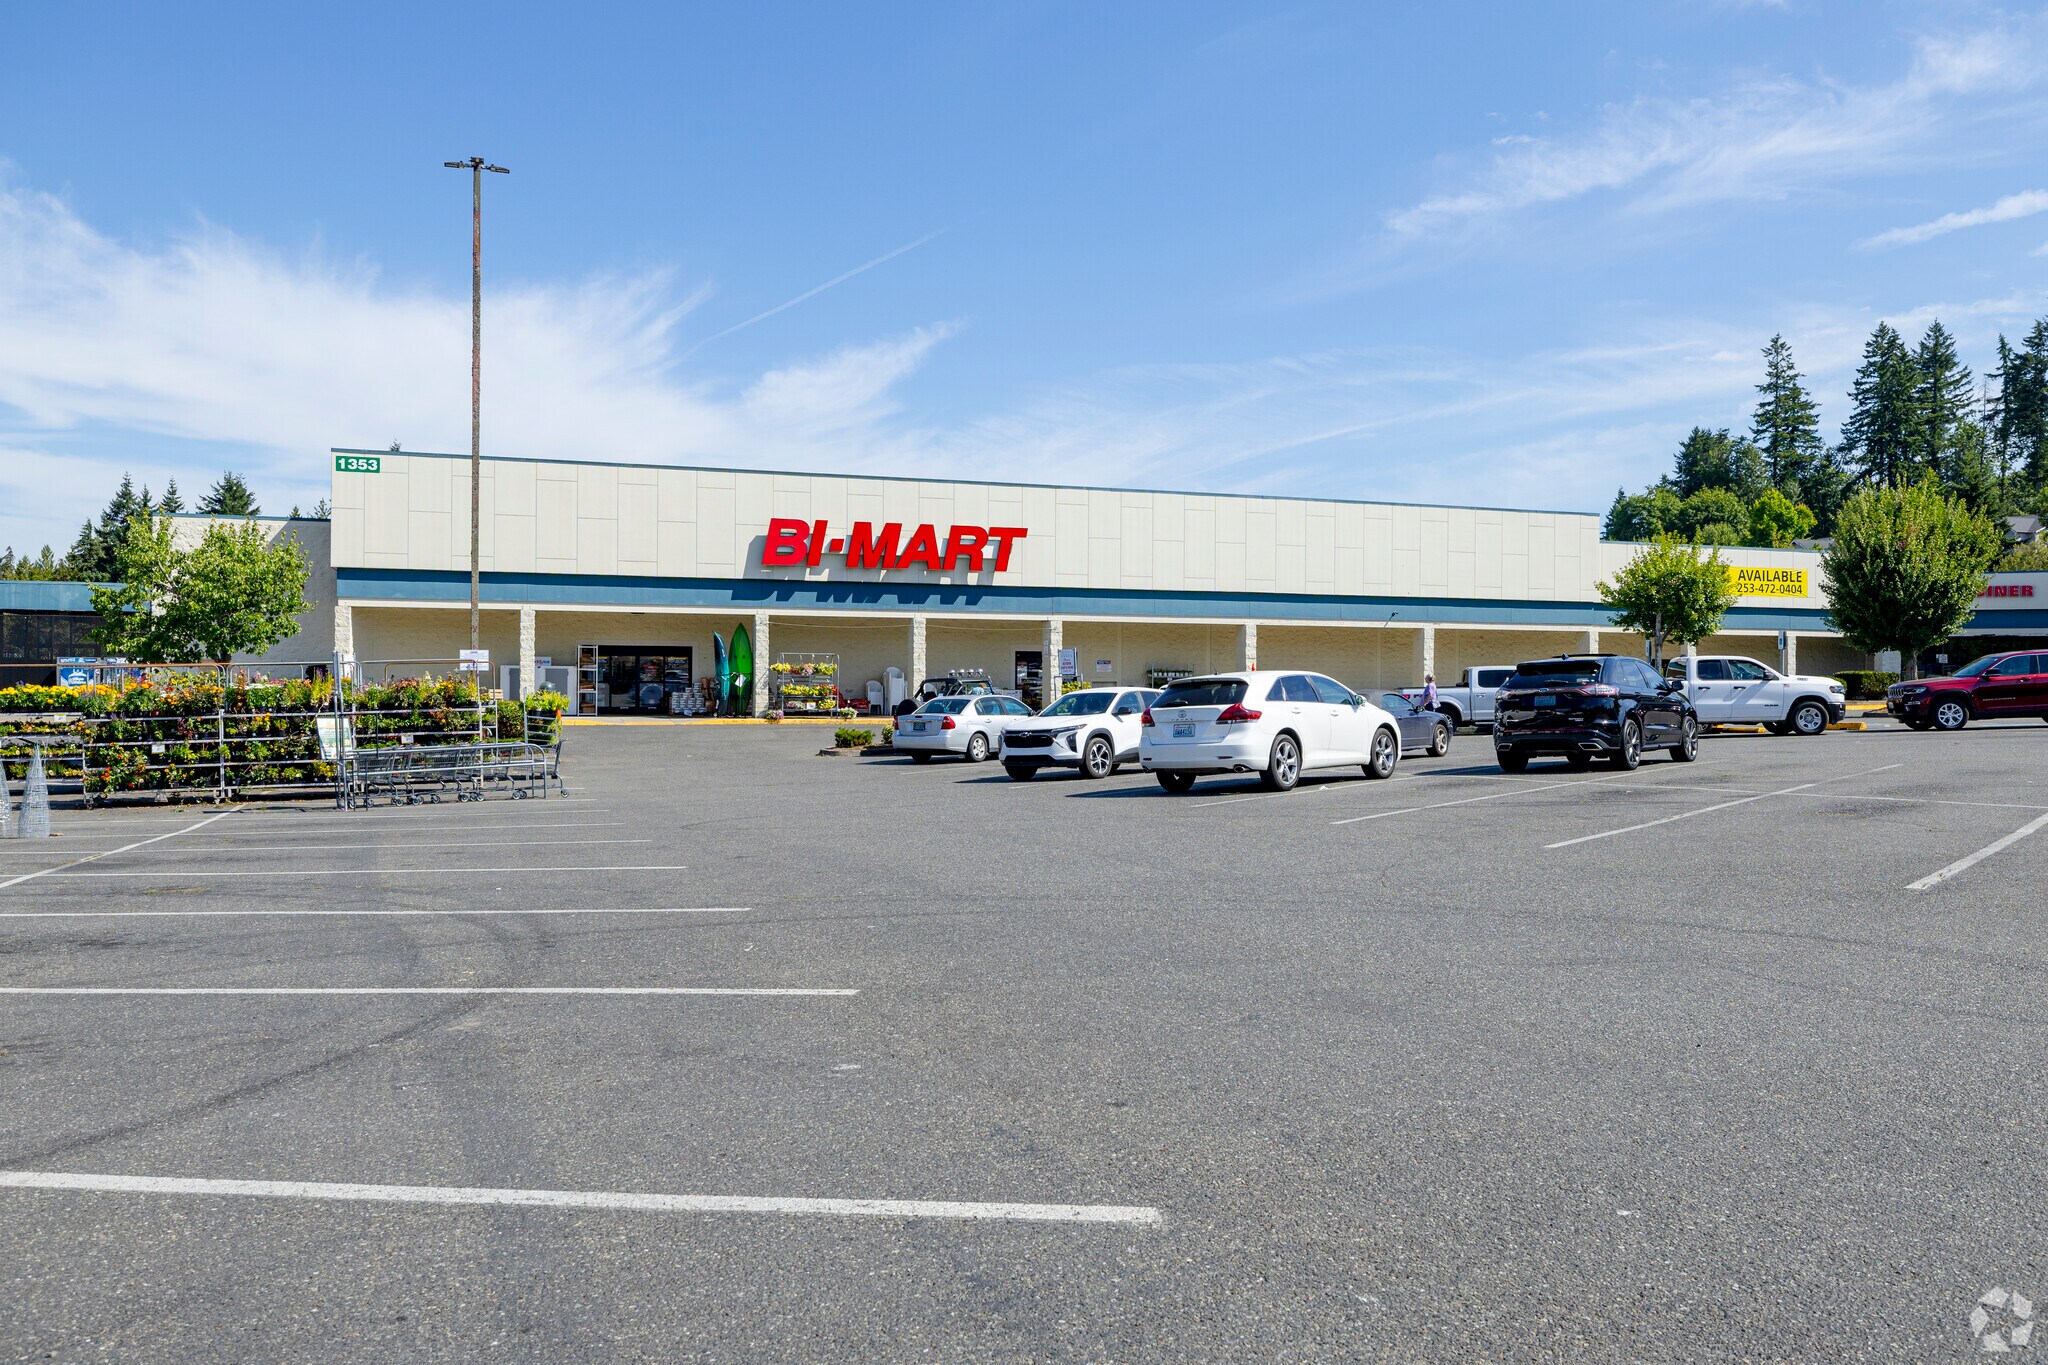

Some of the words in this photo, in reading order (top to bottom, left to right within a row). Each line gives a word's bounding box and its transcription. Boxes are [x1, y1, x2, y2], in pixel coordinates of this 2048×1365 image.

[338, 457, 378, 471] 1353
[761, 517, 1029, 572] BI-MART
[1737, 569, 1803, 583] AVAILABLE
[1737, 583, 1803, 594] 253-472-0404
[1976, 585, 2034, 597] INER
